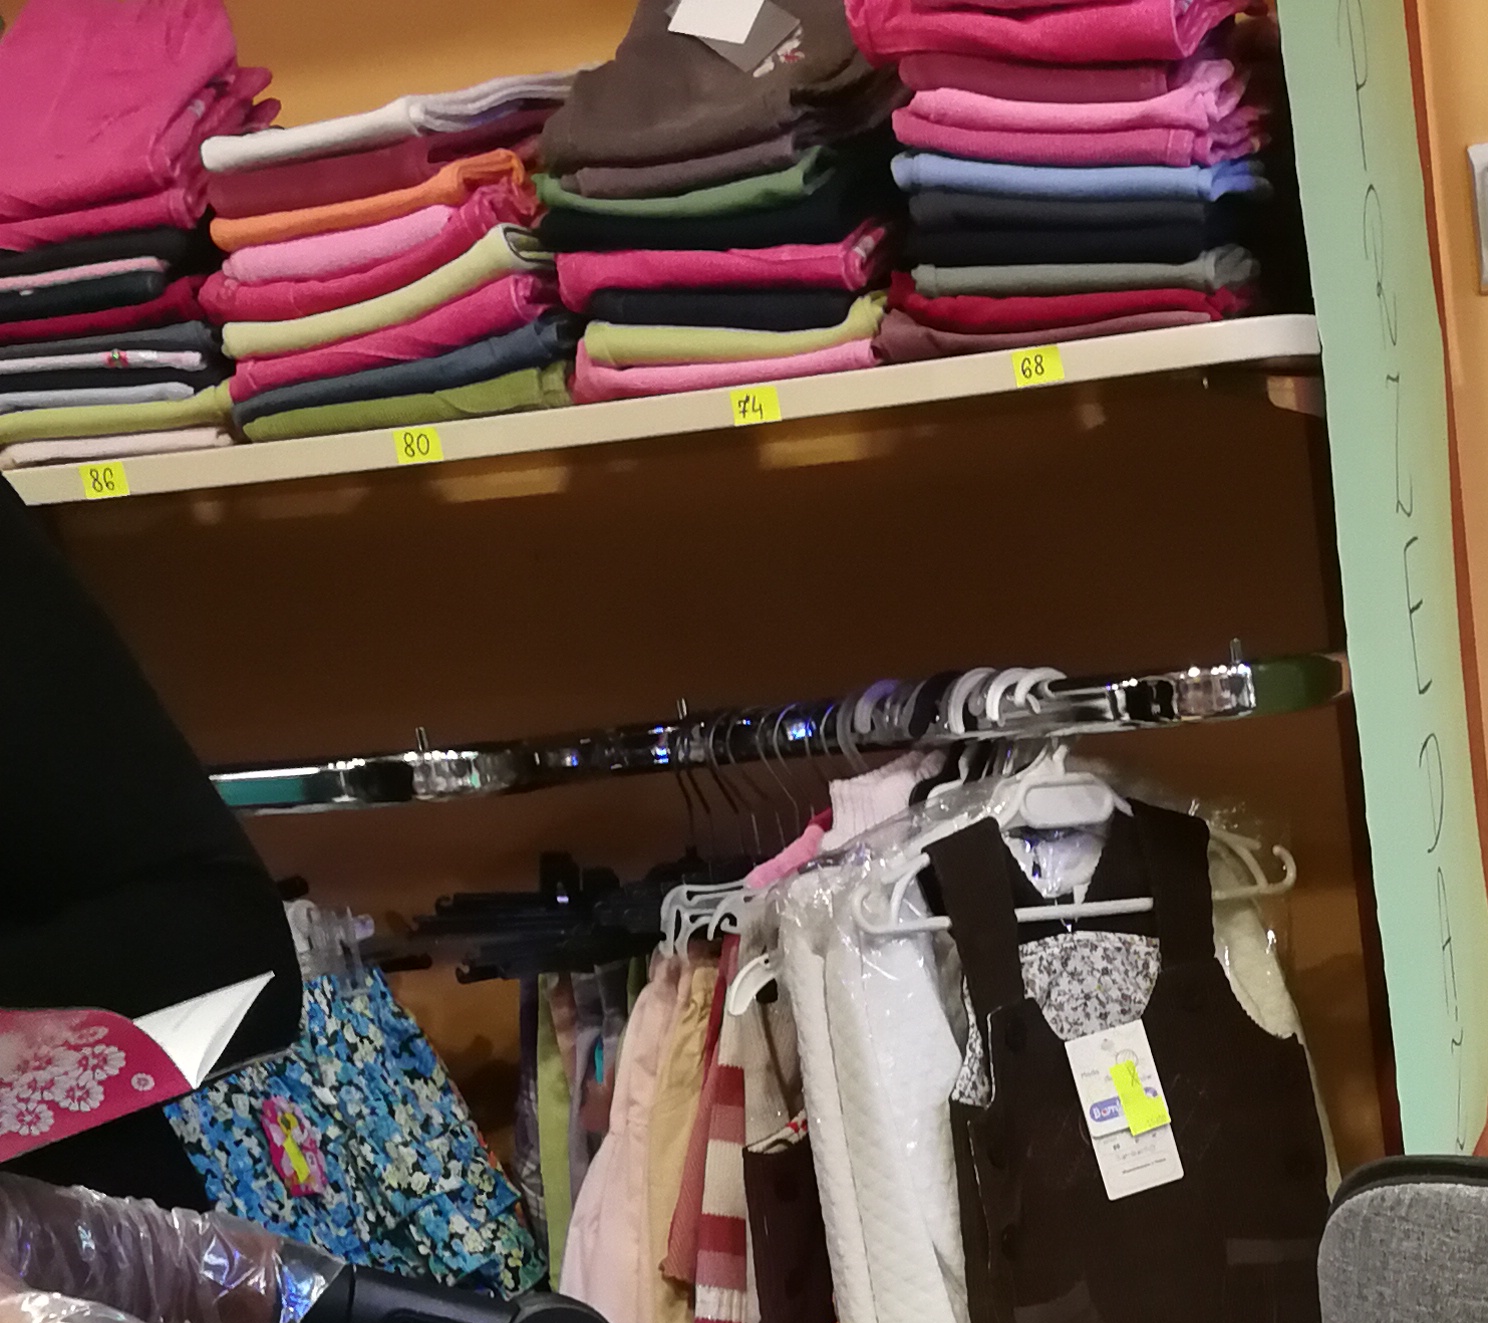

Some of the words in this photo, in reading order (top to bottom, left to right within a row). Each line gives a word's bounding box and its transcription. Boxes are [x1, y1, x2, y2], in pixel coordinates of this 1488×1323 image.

[1021, 354, 1045, 379] 68
[738, 393, 763, 420] 74
[403, 432, 430, 458] 80
[89, 467, 115, 493] 86
